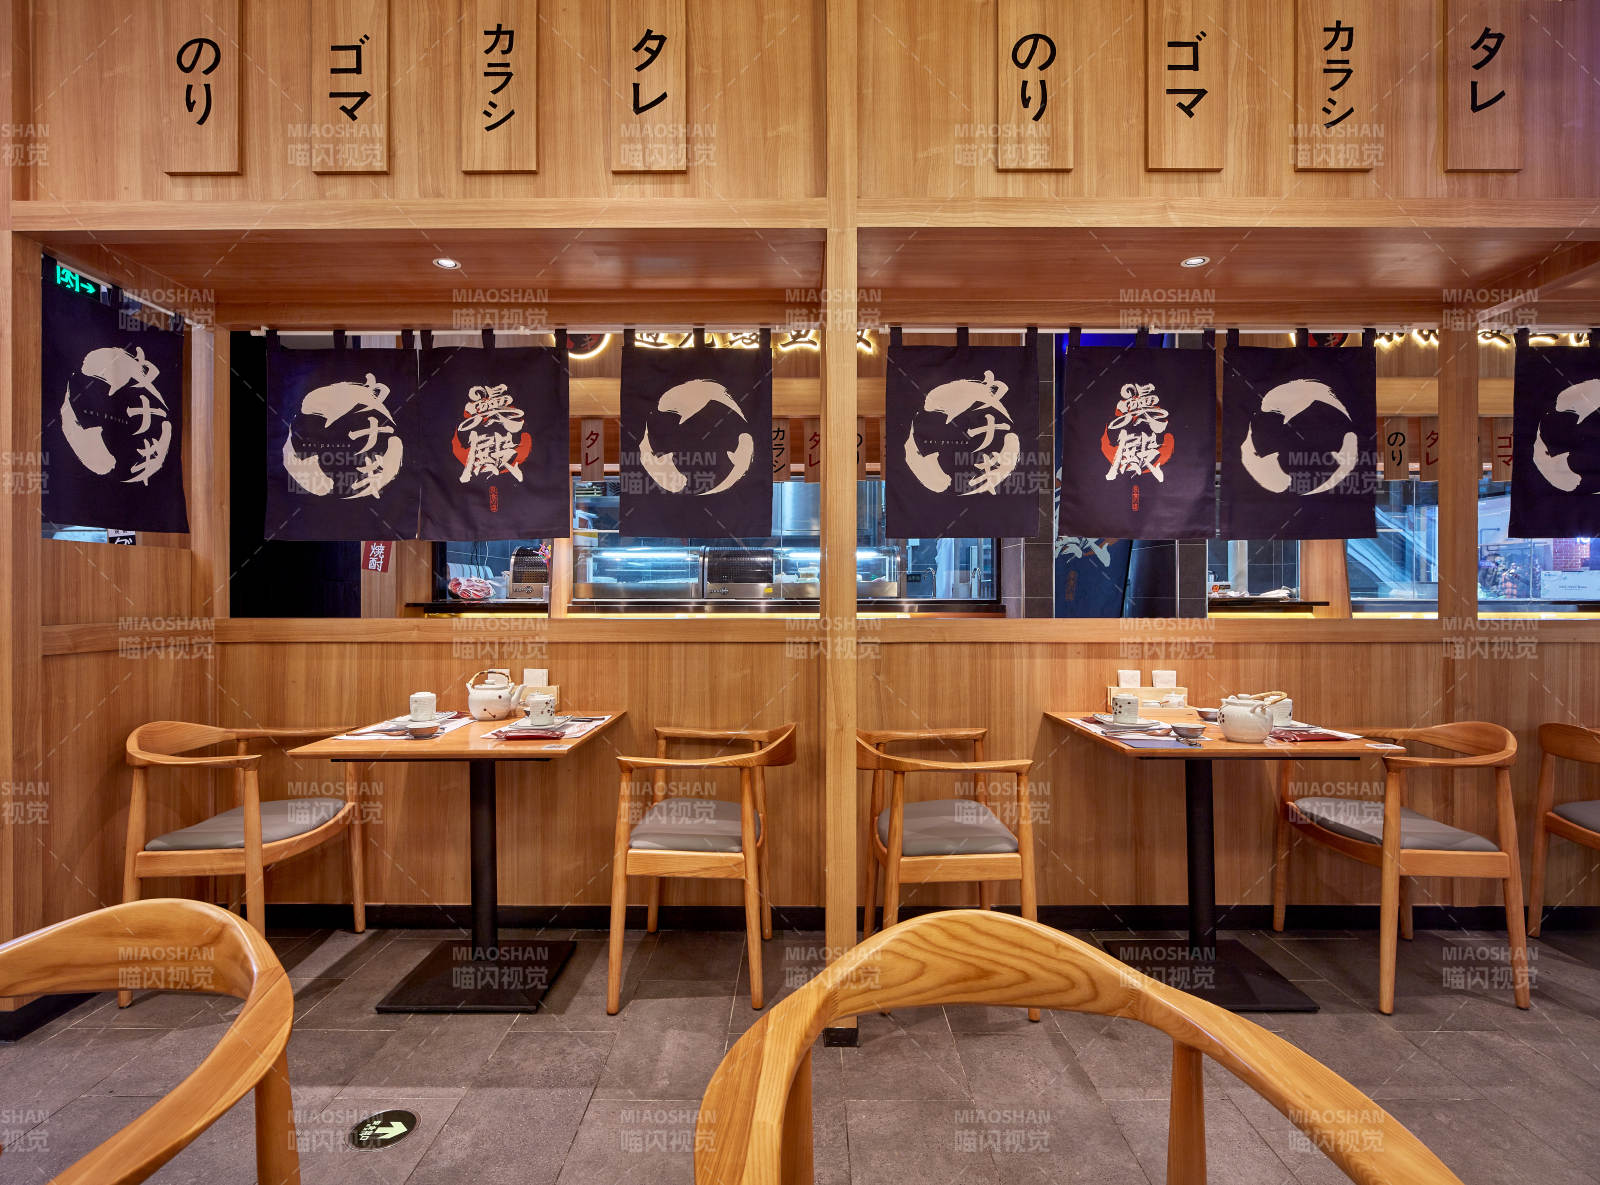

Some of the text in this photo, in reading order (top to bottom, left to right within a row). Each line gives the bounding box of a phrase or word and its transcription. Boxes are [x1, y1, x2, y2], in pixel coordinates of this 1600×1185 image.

[178, 38, 222, 126] のり
[329, 35, 372, 122] ゴマ
[483, 24, 516, 132] カラシ
[632, 29, 669, 116] タレ
[1012, 34, 1057, 122] のり
[1166, 31, 1209, 119] ゴマ
[1322, 20, 1355, 129] カラシ
[1470, 27, 1507, 114] タレ
[585, 430, 600, 466] タレ
[772, 427, 785, 473] カラシ
[1387, 431, 1406, 466] のり
[1425, 430, 1439, 466] タレ
